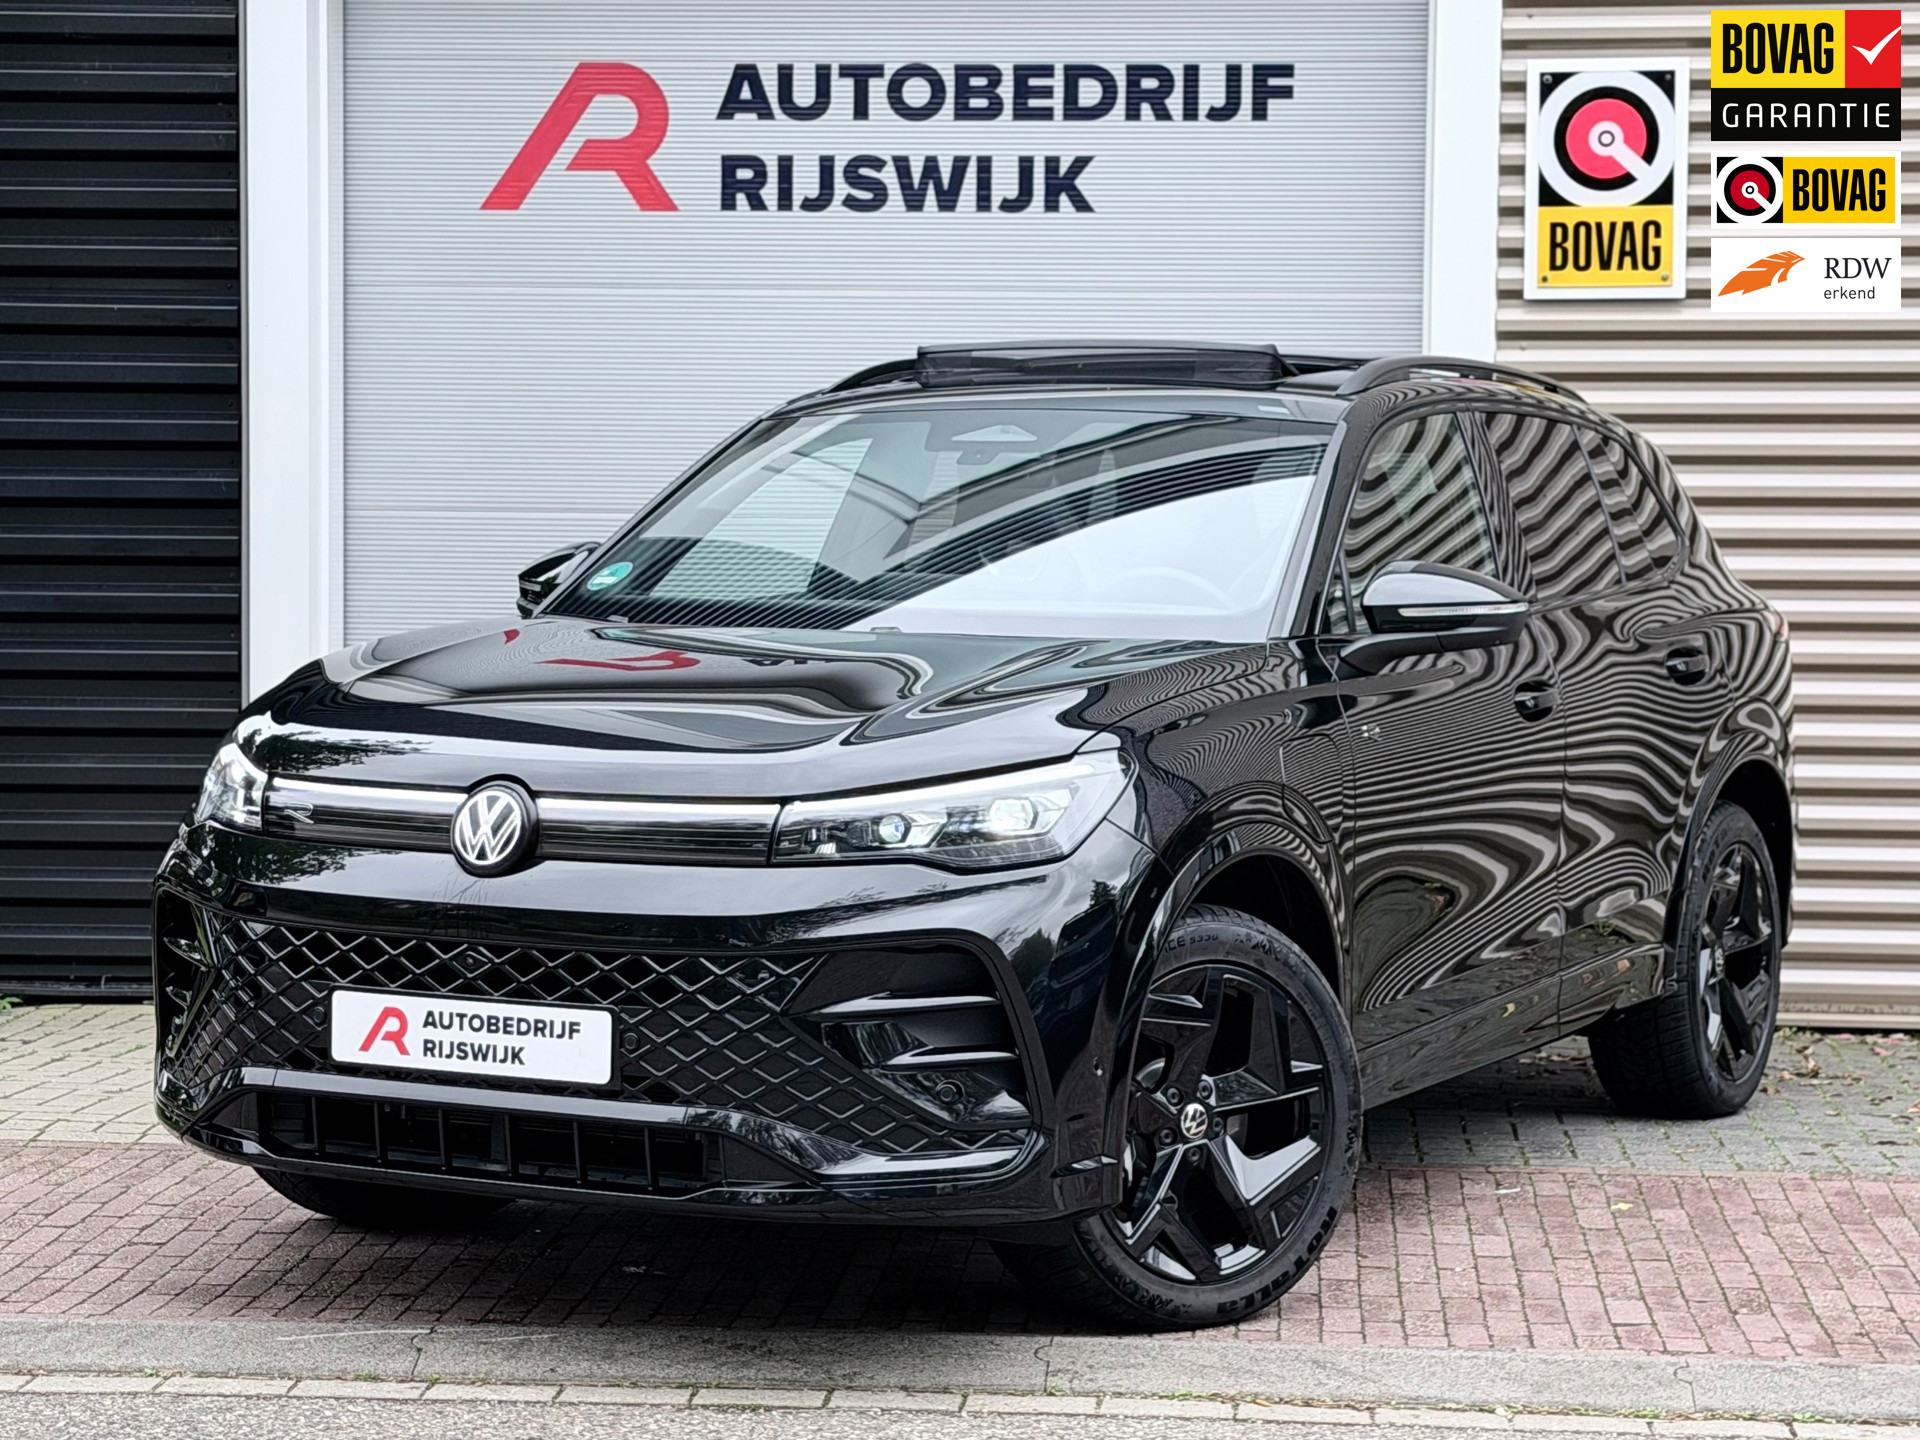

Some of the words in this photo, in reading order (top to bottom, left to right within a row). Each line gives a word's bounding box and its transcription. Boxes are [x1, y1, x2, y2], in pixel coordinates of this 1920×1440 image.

[716, 63, 1295, 122] AUTOBEDRIJF
[721, 154, 1095, 213] RIJSWIJK
[1549, 220, 1662, 272] BOVAG
[422, 1010, 582, 1040] AUTOBEDRIJF
[422, 1039, 526, 1065] RIJSWIJK
